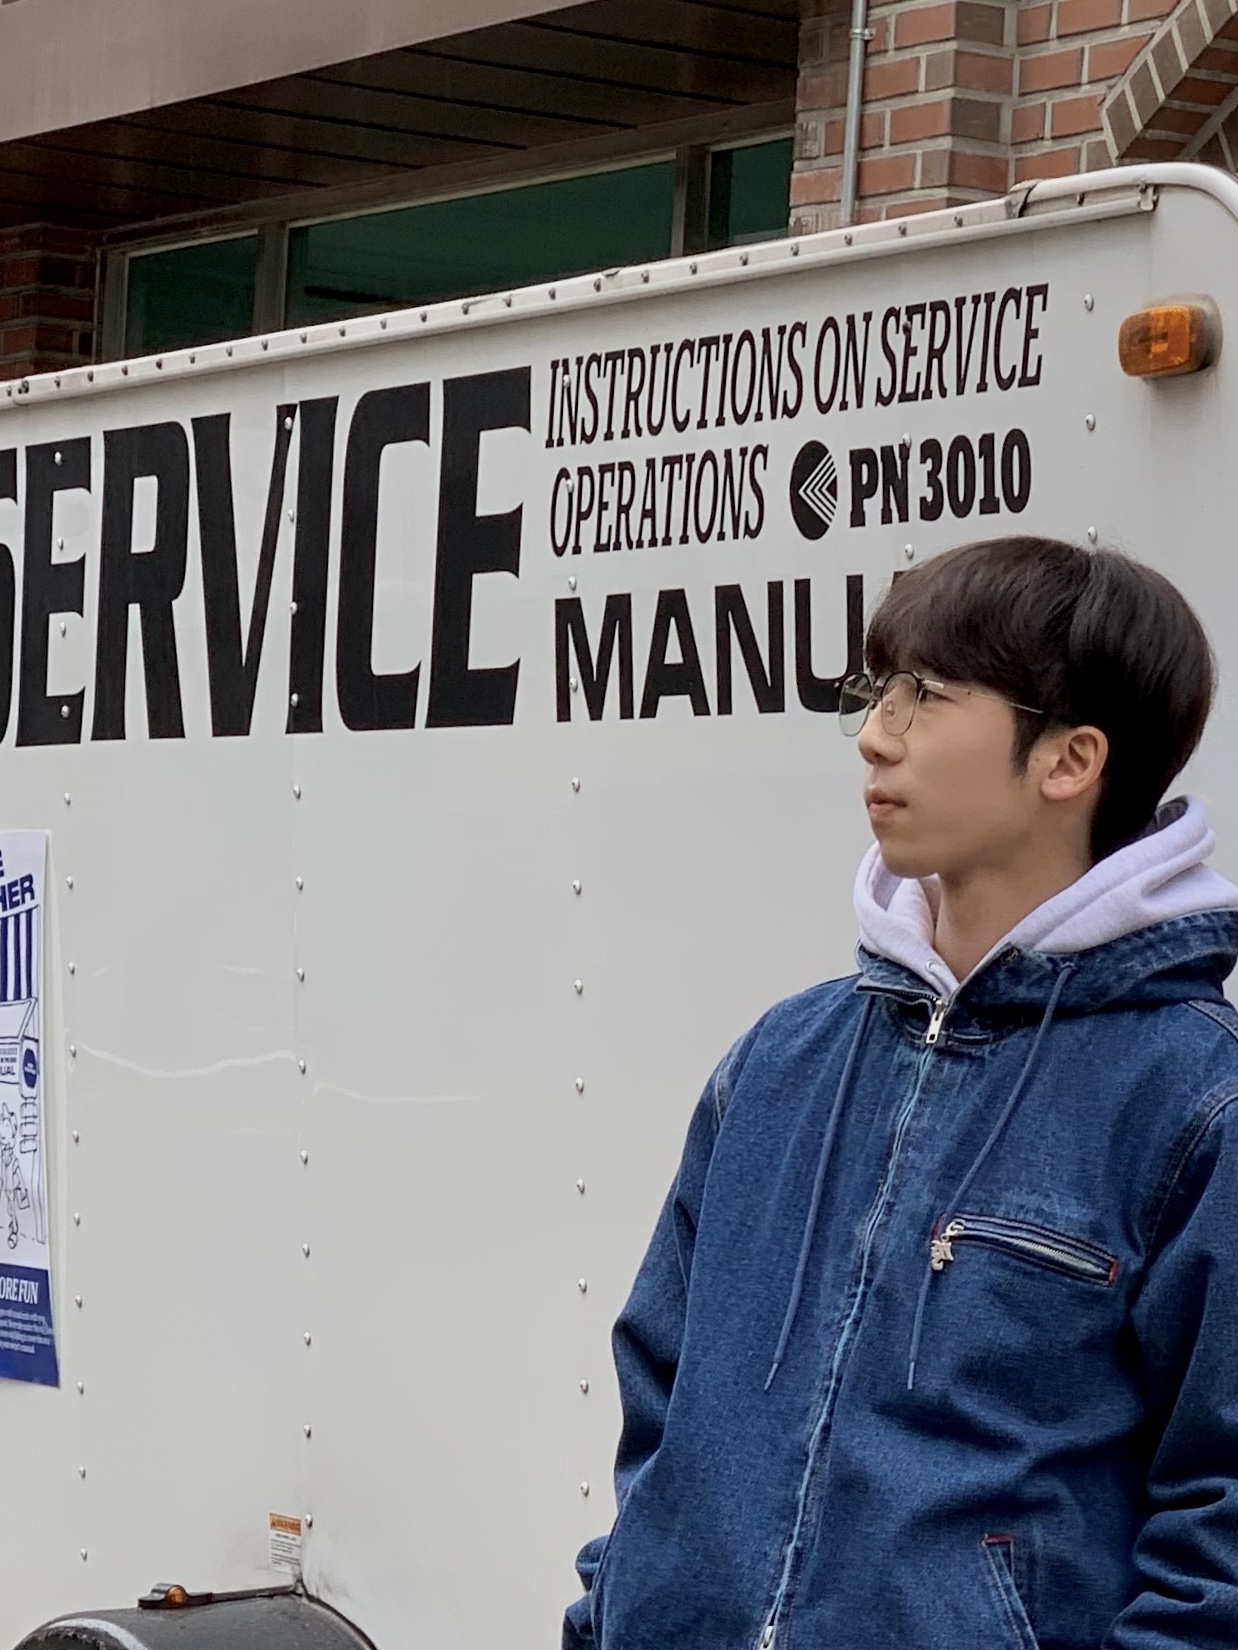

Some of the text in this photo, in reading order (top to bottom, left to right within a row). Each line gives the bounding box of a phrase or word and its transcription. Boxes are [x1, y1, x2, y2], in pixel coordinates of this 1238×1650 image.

[546, 283, 1049, 449] INSTRUCTIONS ON SERVICE
[0, 366, 532, 748] ERVICE
[551, 428, 1031, 557] OPERATIONS PN 3010
[555, 571, 905, 723] MANU
[19, 1279, 39, 1304] FUN
